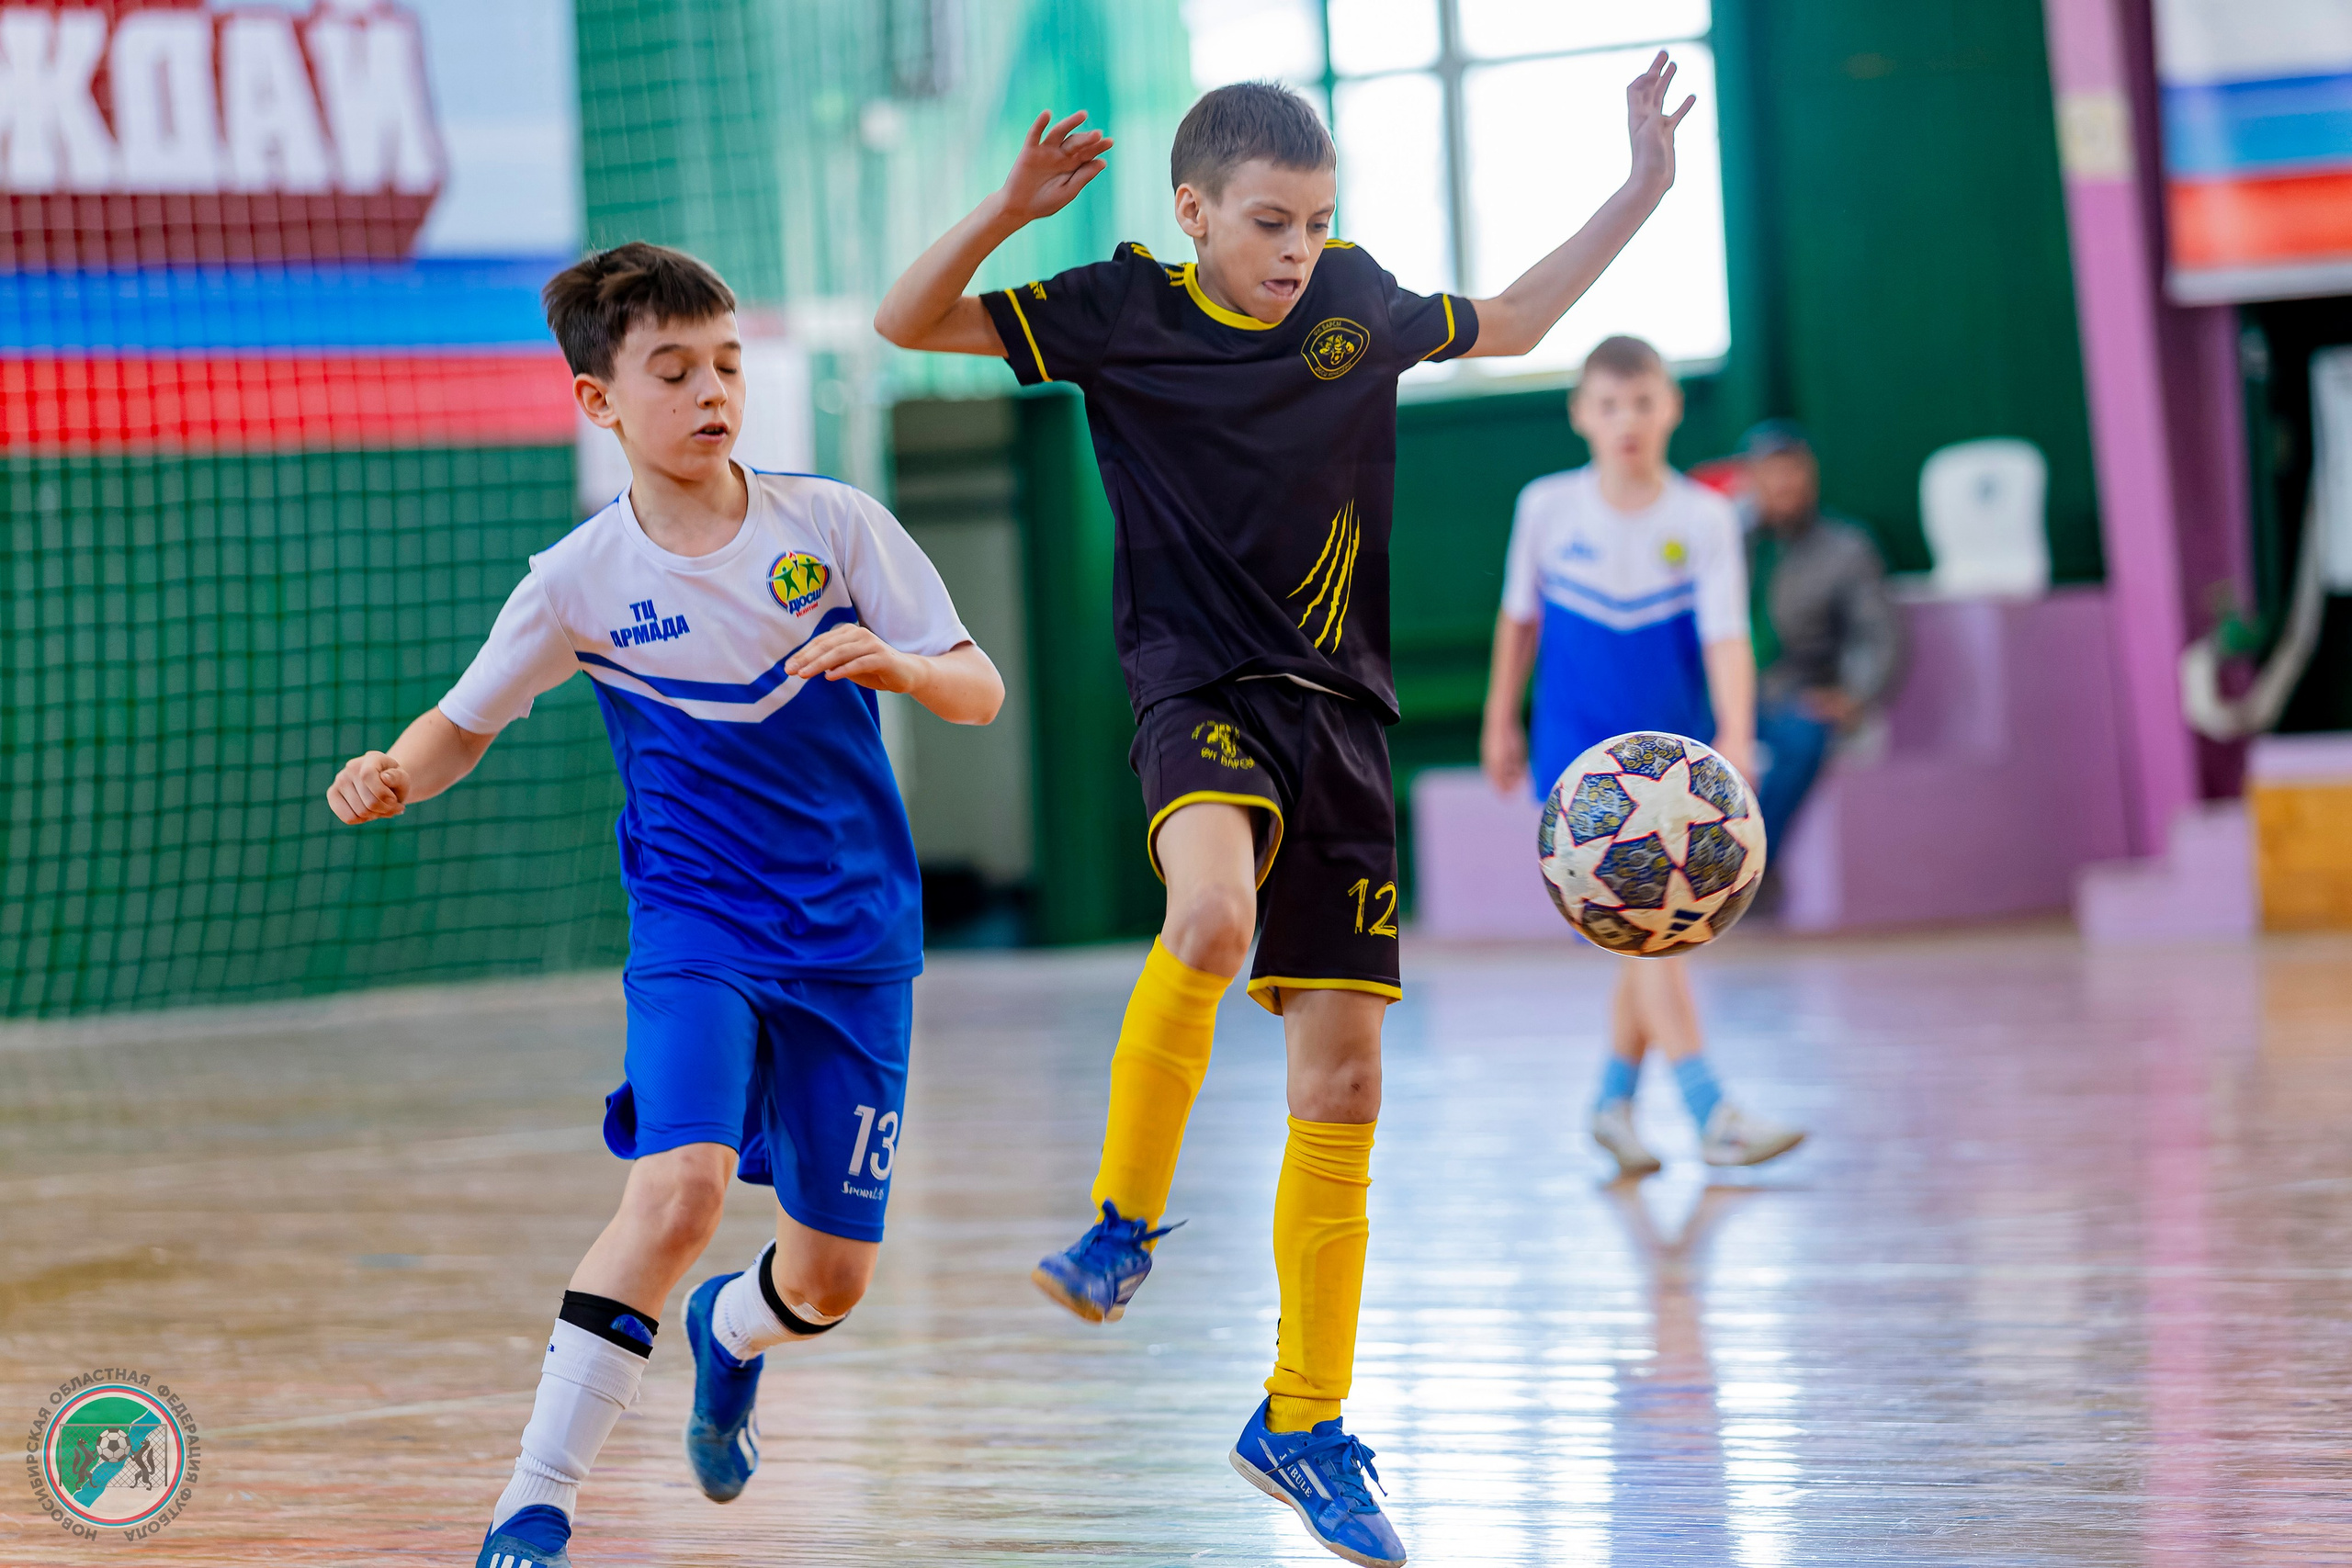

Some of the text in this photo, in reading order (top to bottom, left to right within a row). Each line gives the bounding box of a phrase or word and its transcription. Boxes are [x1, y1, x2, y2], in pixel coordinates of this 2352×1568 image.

[629, 599, 657, 622] ТЦ
[788, 587, 821, 615] ДЮСШ
[610, 615, 690, 648] АРМАДА
[1348, 878, 1397, 939] 12
[848, 1104, 899, 1180] 13
